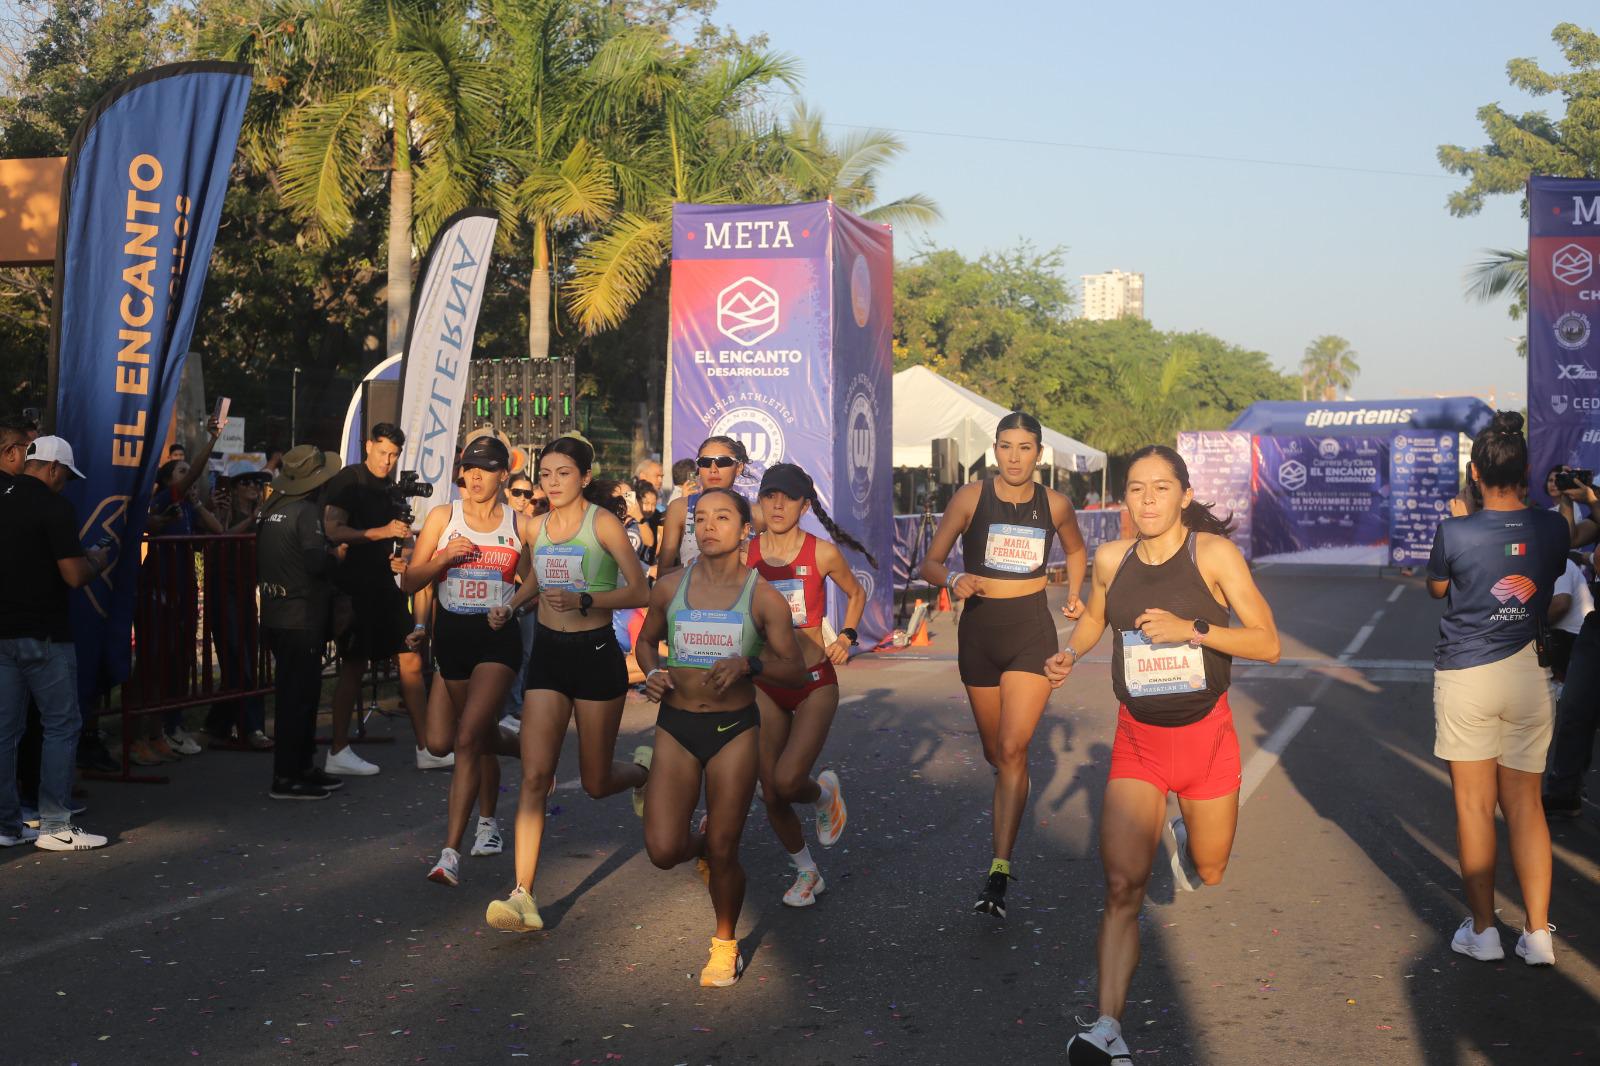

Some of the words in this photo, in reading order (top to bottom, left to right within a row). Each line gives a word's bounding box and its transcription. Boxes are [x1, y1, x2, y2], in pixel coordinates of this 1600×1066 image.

[704, 221, 794, 249] META
[115, 153, 163, 395] ENCANTO
[694, 351, 715, 363] EL
[719, 350, 802, 363] ENCANTO
[707, 367, 790, 377] DESARROLLOS
[703, 394, 735, 422] WORLD
[740, 392, 795, 424] ATHLETICS
[112, 410, 146, 467] EL
[1310, 467, 1323, 476] EL
[1325, 467, 1377, 476] ENCANTO
[992, 547, 1038, 560] FERNANDA
[458, 580, 488, 599] 128
[683, 631, 734, 647] VERÓNICA
[1137, 655, 1190, 673] DANIELA
